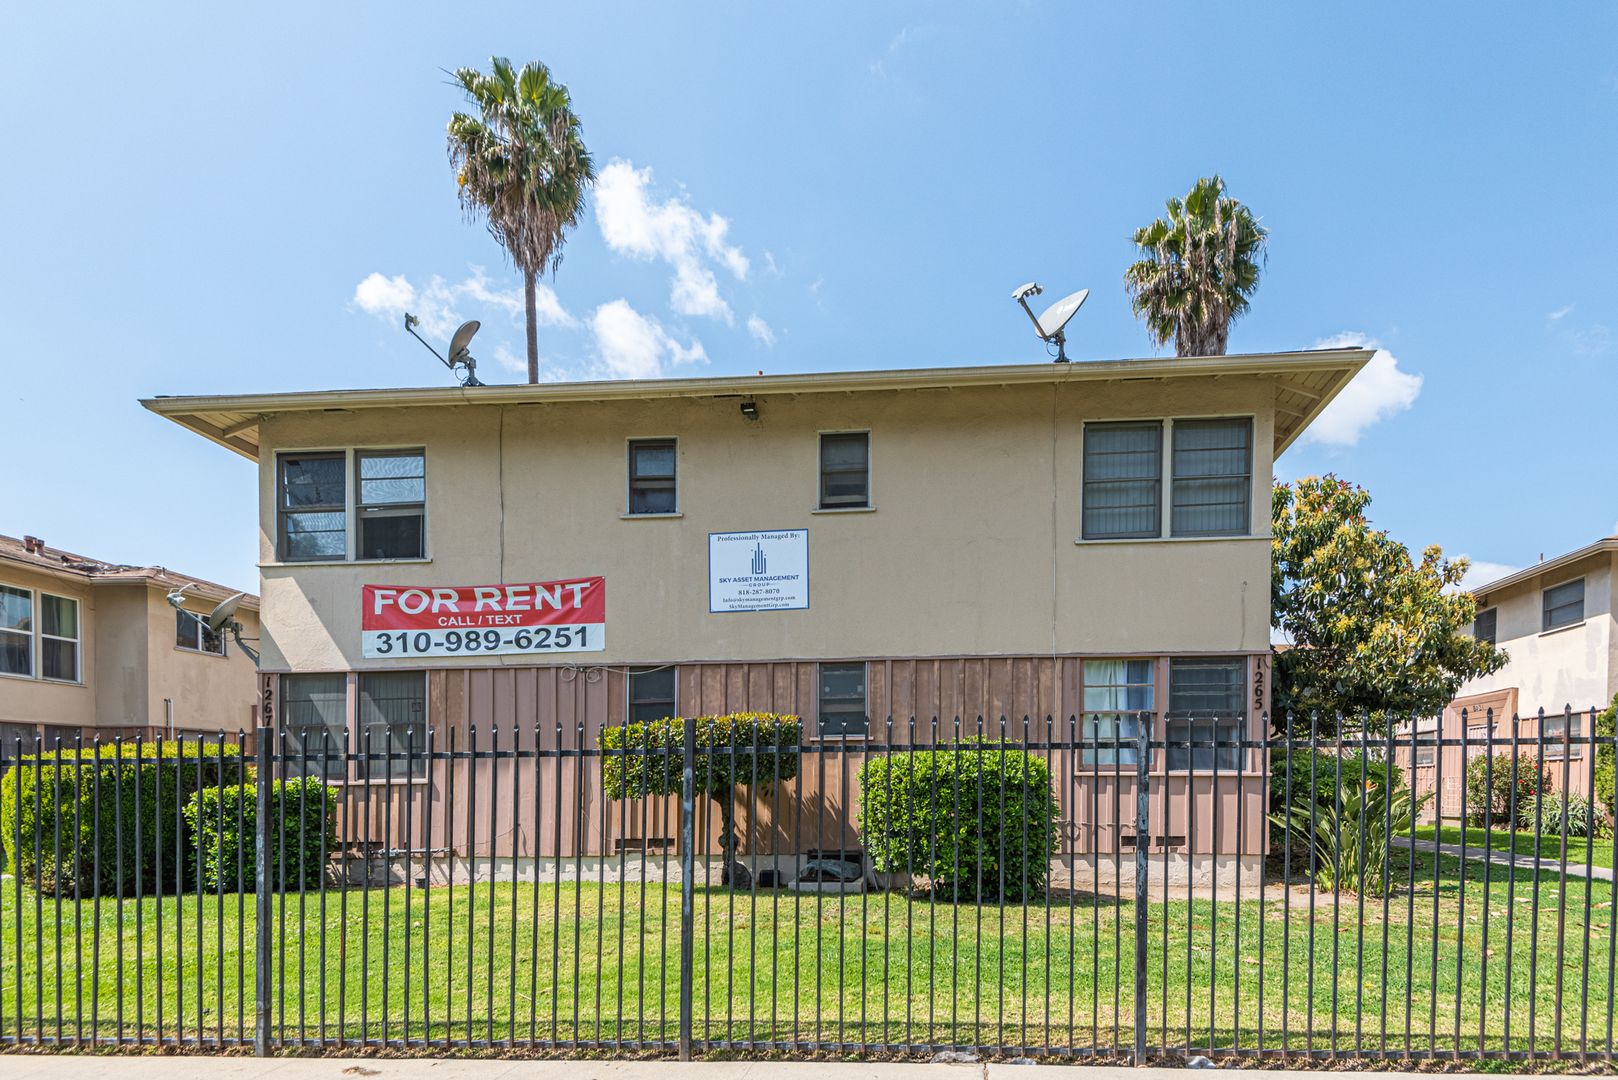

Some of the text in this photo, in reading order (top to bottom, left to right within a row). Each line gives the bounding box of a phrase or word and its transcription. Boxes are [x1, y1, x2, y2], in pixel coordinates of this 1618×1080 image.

[374, 583, 590, 615] FOR RENT
[438, 614, 522, 627] CALL / TEXT
[376, 626, 588, 654] 310-989-6251
[1255, 658, 1263, 710] 1265
